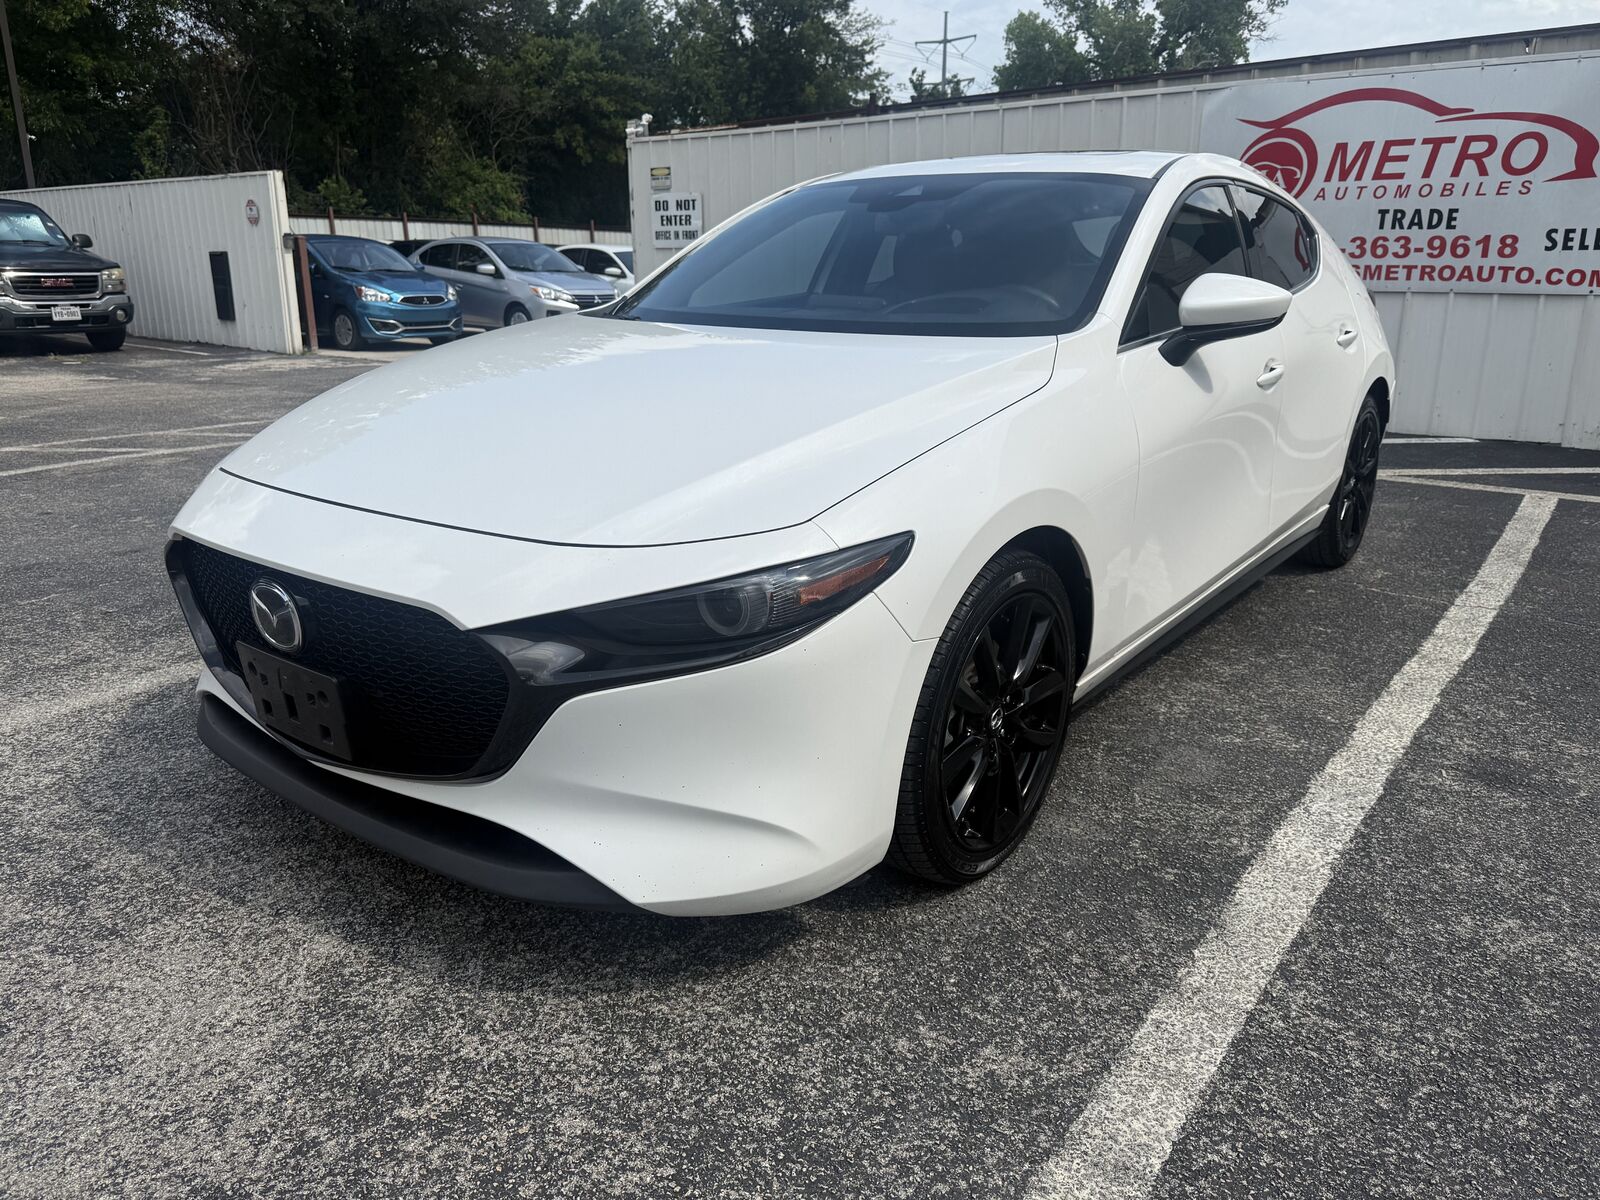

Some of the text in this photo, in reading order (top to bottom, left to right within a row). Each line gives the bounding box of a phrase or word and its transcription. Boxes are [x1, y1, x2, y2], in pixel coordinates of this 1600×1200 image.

[1324, 131, 1549, 182] METRO
[1313, 180, 1534, 202] AUTOMOBILES
[654, 199, 697, 212] DO NOT
[660, 214, 692, 227] ENTER
[1377, 208, 1460, 230] TRADE
[655, 230, 699, 241] OFFICE IN FRONT
